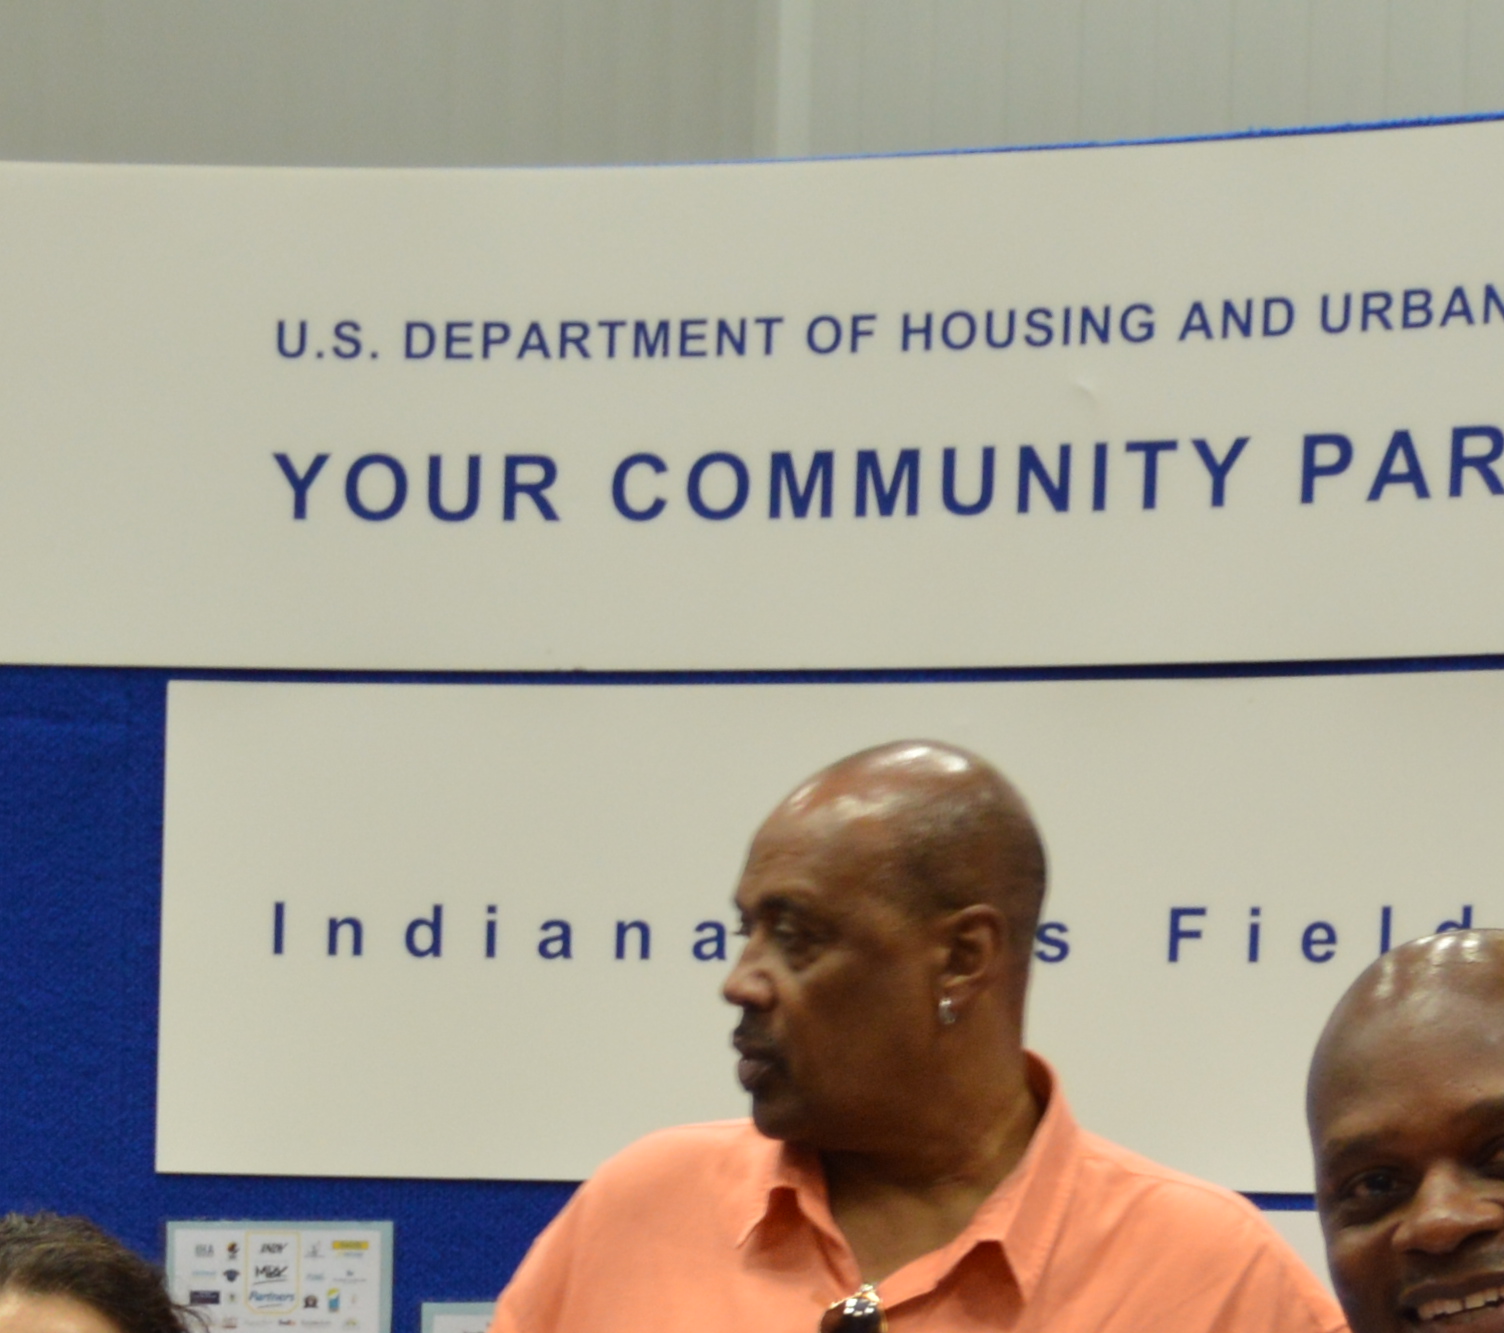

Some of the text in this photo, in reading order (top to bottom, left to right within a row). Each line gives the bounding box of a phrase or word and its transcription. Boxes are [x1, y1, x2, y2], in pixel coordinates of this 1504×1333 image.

[276, 319, 378, 360] U.S.
[404, 316, 784, 360] DEPARTMENT
[806, 313, 877, 355] OF
[901, 302, 1155, 352] HOUSING
[1178, 296, 1295, 342] AND
[272, 452, 560, 523] YOUR
[611, 436, 1250, 523] COMMUNITY
[272, 900, 1070, 964] Indianas
